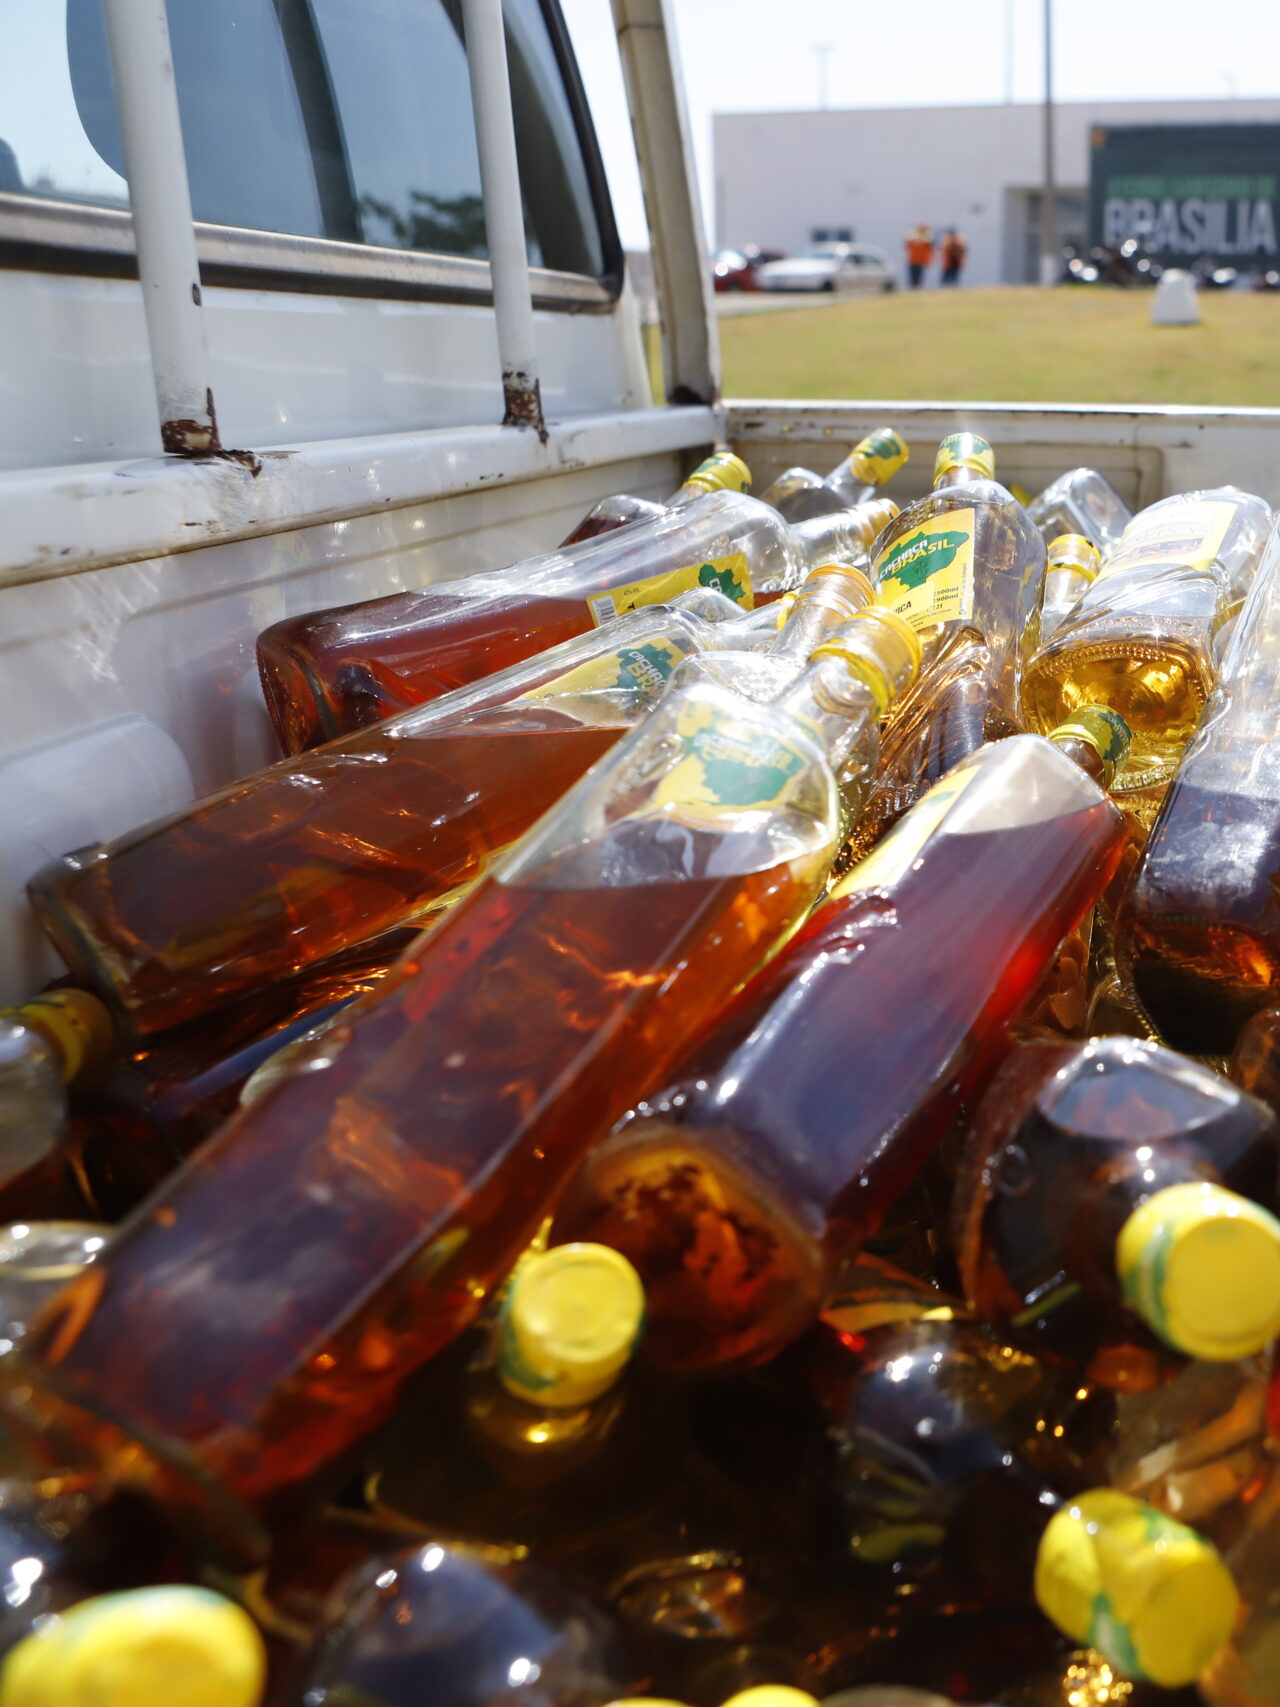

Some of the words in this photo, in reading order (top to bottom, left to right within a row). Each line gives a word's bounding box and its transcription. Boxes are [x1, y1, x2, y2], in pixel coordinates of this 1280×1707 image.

[891, 538, 955, 575] BRASIL
[936, 593, 959, 602] 900ml
[895, 600, 912, 615] ICA
